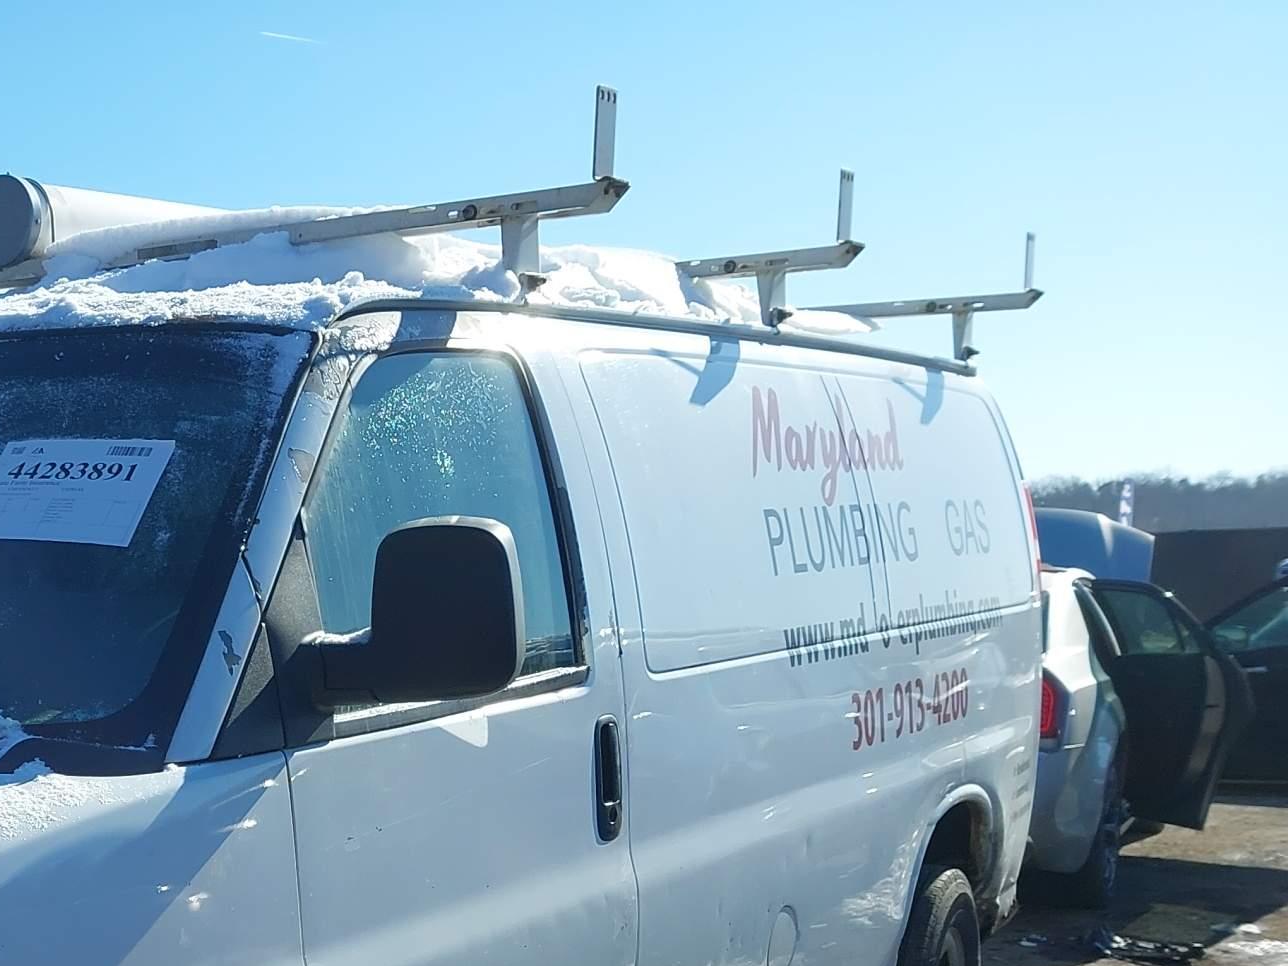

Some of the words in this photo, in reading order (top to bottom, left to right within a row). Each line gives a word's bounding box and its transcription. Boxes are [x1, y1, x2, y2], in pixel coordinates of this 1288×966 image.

[8, 462, 138, 481] 44283891
[752, 386, 904, 505] Maryland
[763, 501, 918, 576] PLUMBING
[944, 499, 991, 556] GAS
[851, 667, 969, 750] 301-913-4200
